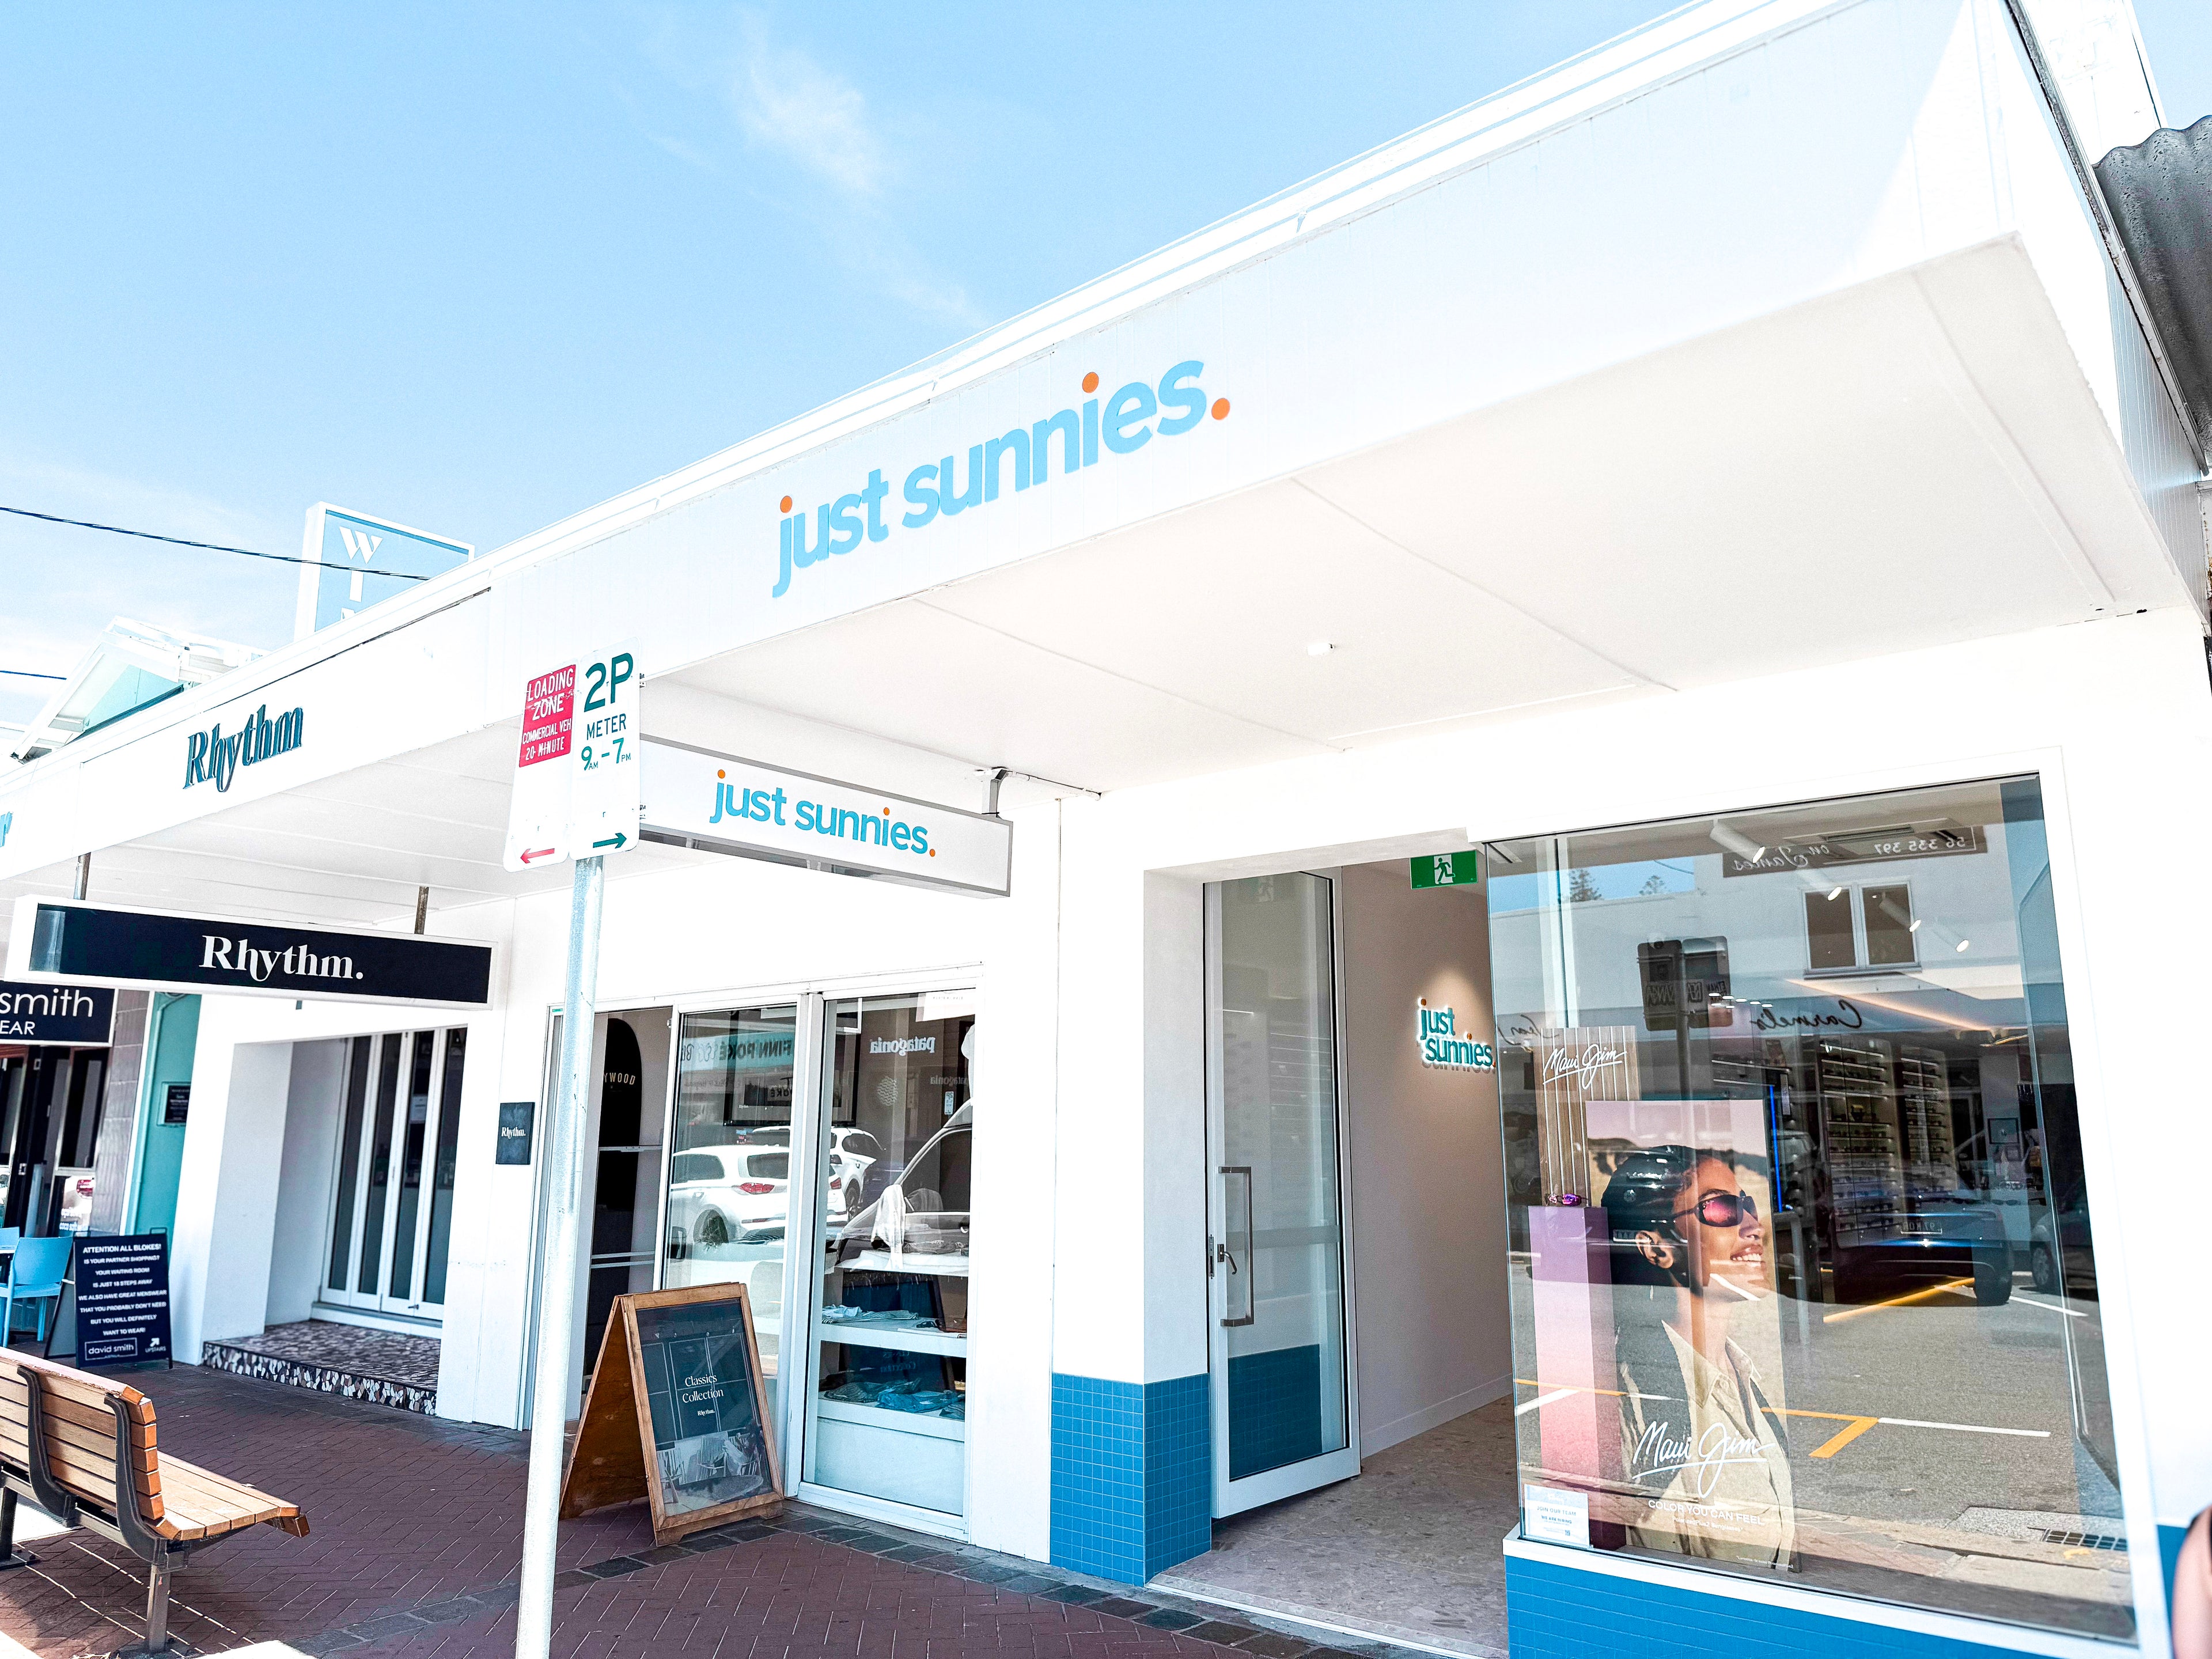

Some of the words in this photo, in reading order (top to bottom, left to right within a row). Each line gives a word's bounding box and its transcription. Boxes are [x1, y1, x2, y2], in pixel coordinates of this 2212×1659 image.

[772, 469, 889, 597] just
[902, 359, 1231, 529] sunnies.
[528, 668, 573, 702] LOADING
[584, 653, 634, 712] 2P
[532, 692, 565, 721] ZONE
[522, 722, 558, 745] COMMERCIAL
[559, 718, 571, 733] VEH
[587, 714, 627, 740] METER
[183, 704, 304, 793] Rhythm
[537, 736, 565, 757] MINUTE
[710, 769, 787, 825] just
[795, 799, 935, 857] sunnies.
[199, 935, 364, 982] Rhythm.
[0, 988, 93, 1017] smith
[1421, 998, 1456, 1040] just
[1426, 1033, 1496, 1068] sunnies.
[1543, 1047, 1580, 1076] Maui
[1581, 1043, 1627, 1090] Jim
[501, 1127, 526, 1139] Rhythm.
[83, 1245, 119, 1253] ATTENTION
[133, 1243, 161, 1251] BLOKES!
[88, 1345, 112, 1354] david
[113, 1343, 134, 1351] smith
[685, 1374, 717, 1387] Classics
[683, 1389, 724, 1403] Collection
[1632, 1420, 1692, 1468] Maui
[1697, 1422, 1775, 1498] Jim
[1648, 1499, 1685, 1514] COLOR
[1684, 1505, 1710, 1517] YOU
[1710, 1509, 1733, 1521] CAN
[1736, 1513, 1766, 1526] FEEL
